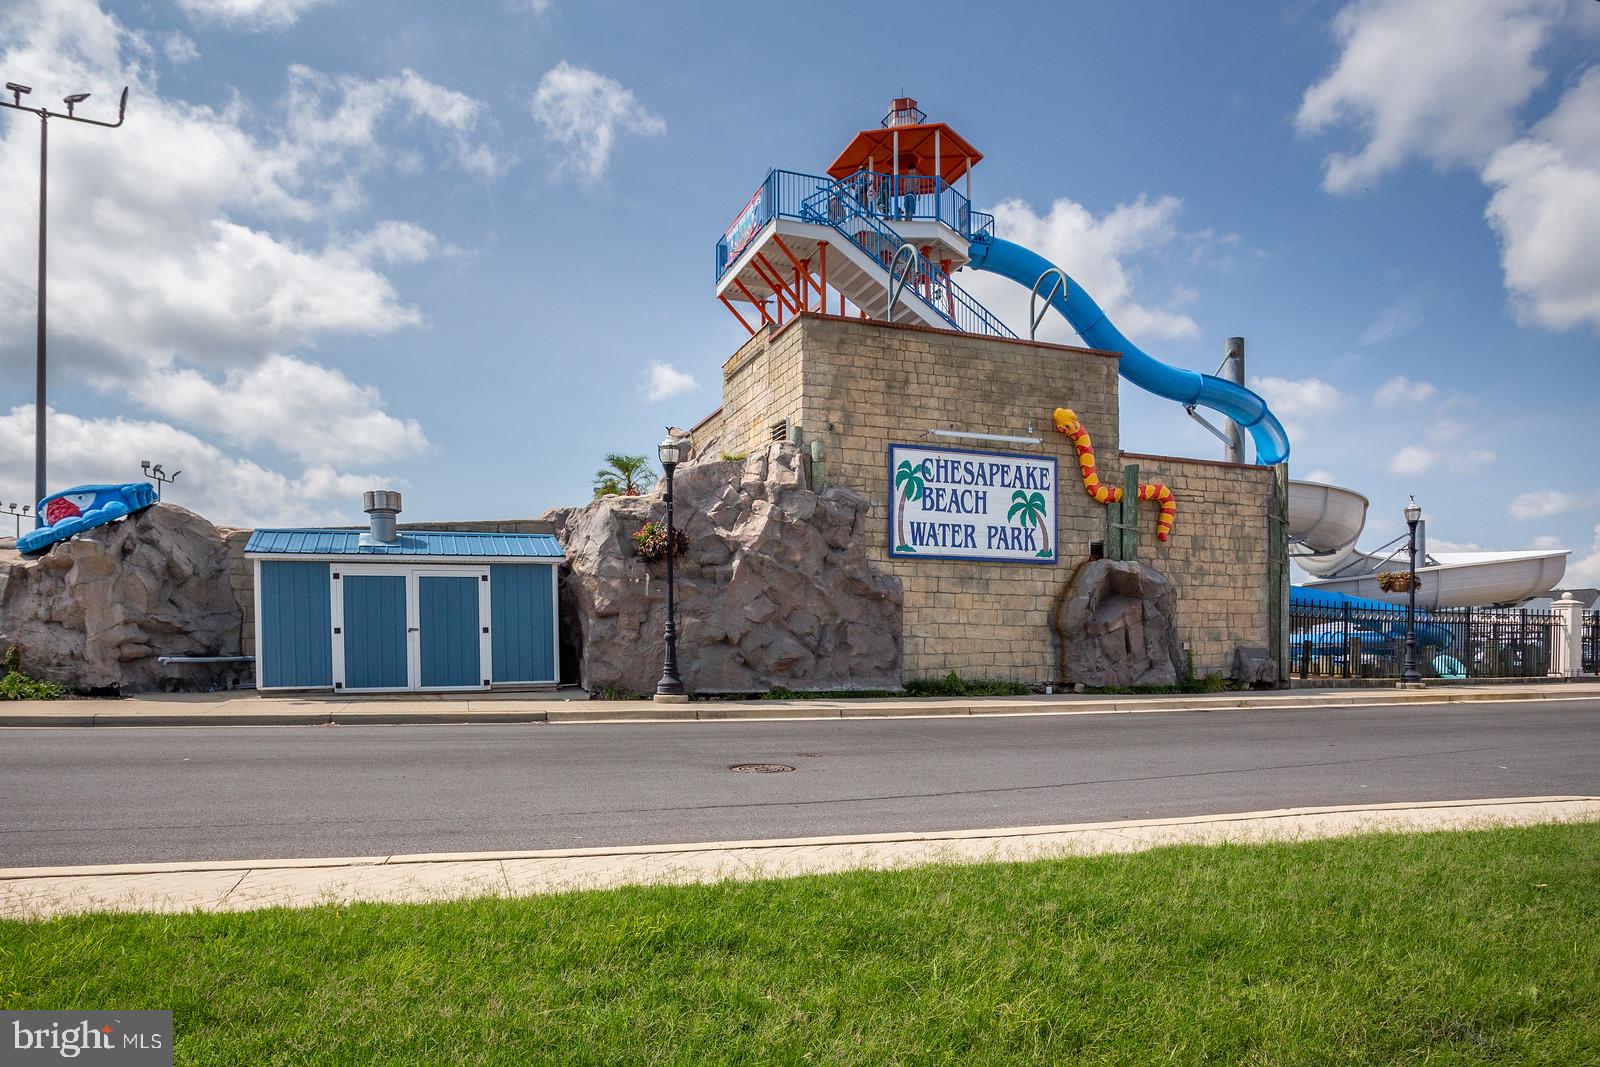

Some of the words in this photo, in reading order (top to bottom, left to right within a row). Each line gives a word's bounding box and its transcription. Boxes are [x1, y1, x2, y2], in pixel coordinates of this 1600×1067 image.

[921, 457, 1051, 491] CHESAPEAKE
[921, 487, 988, 514] BEACH
[909, 521, 977, 548] WATER
[987, 525, 1037, 552] PARK
